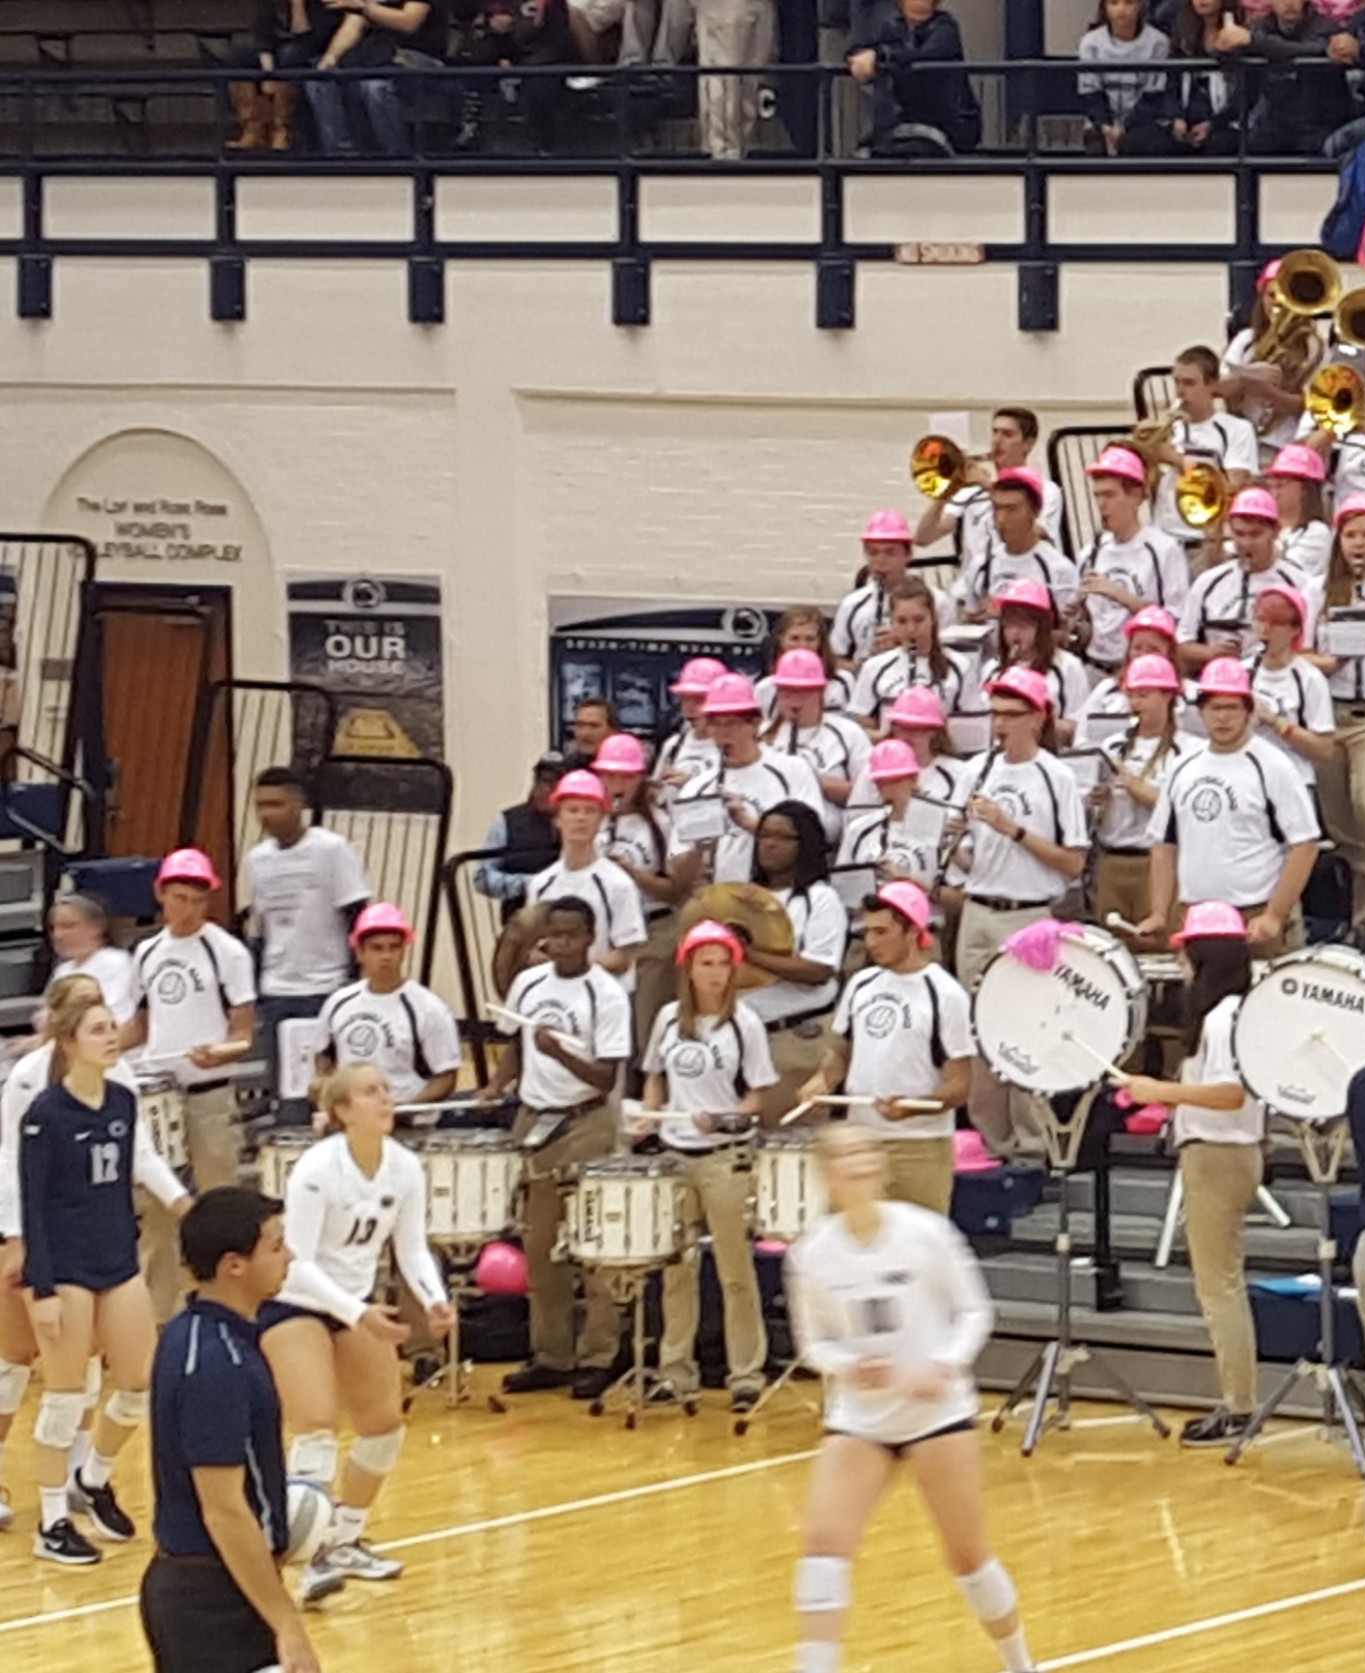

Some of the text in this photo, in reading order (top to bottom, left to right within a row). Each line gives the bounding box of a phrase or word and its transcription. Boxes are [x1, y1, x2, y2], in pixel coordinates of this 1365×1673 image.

[166, 543, 243, 562] COMPLEX
[325, 635, 406, 659] OUR
[1302, 983, 1365, 1014] YAMAHA
[91, 1143, 119, 1184] 12
